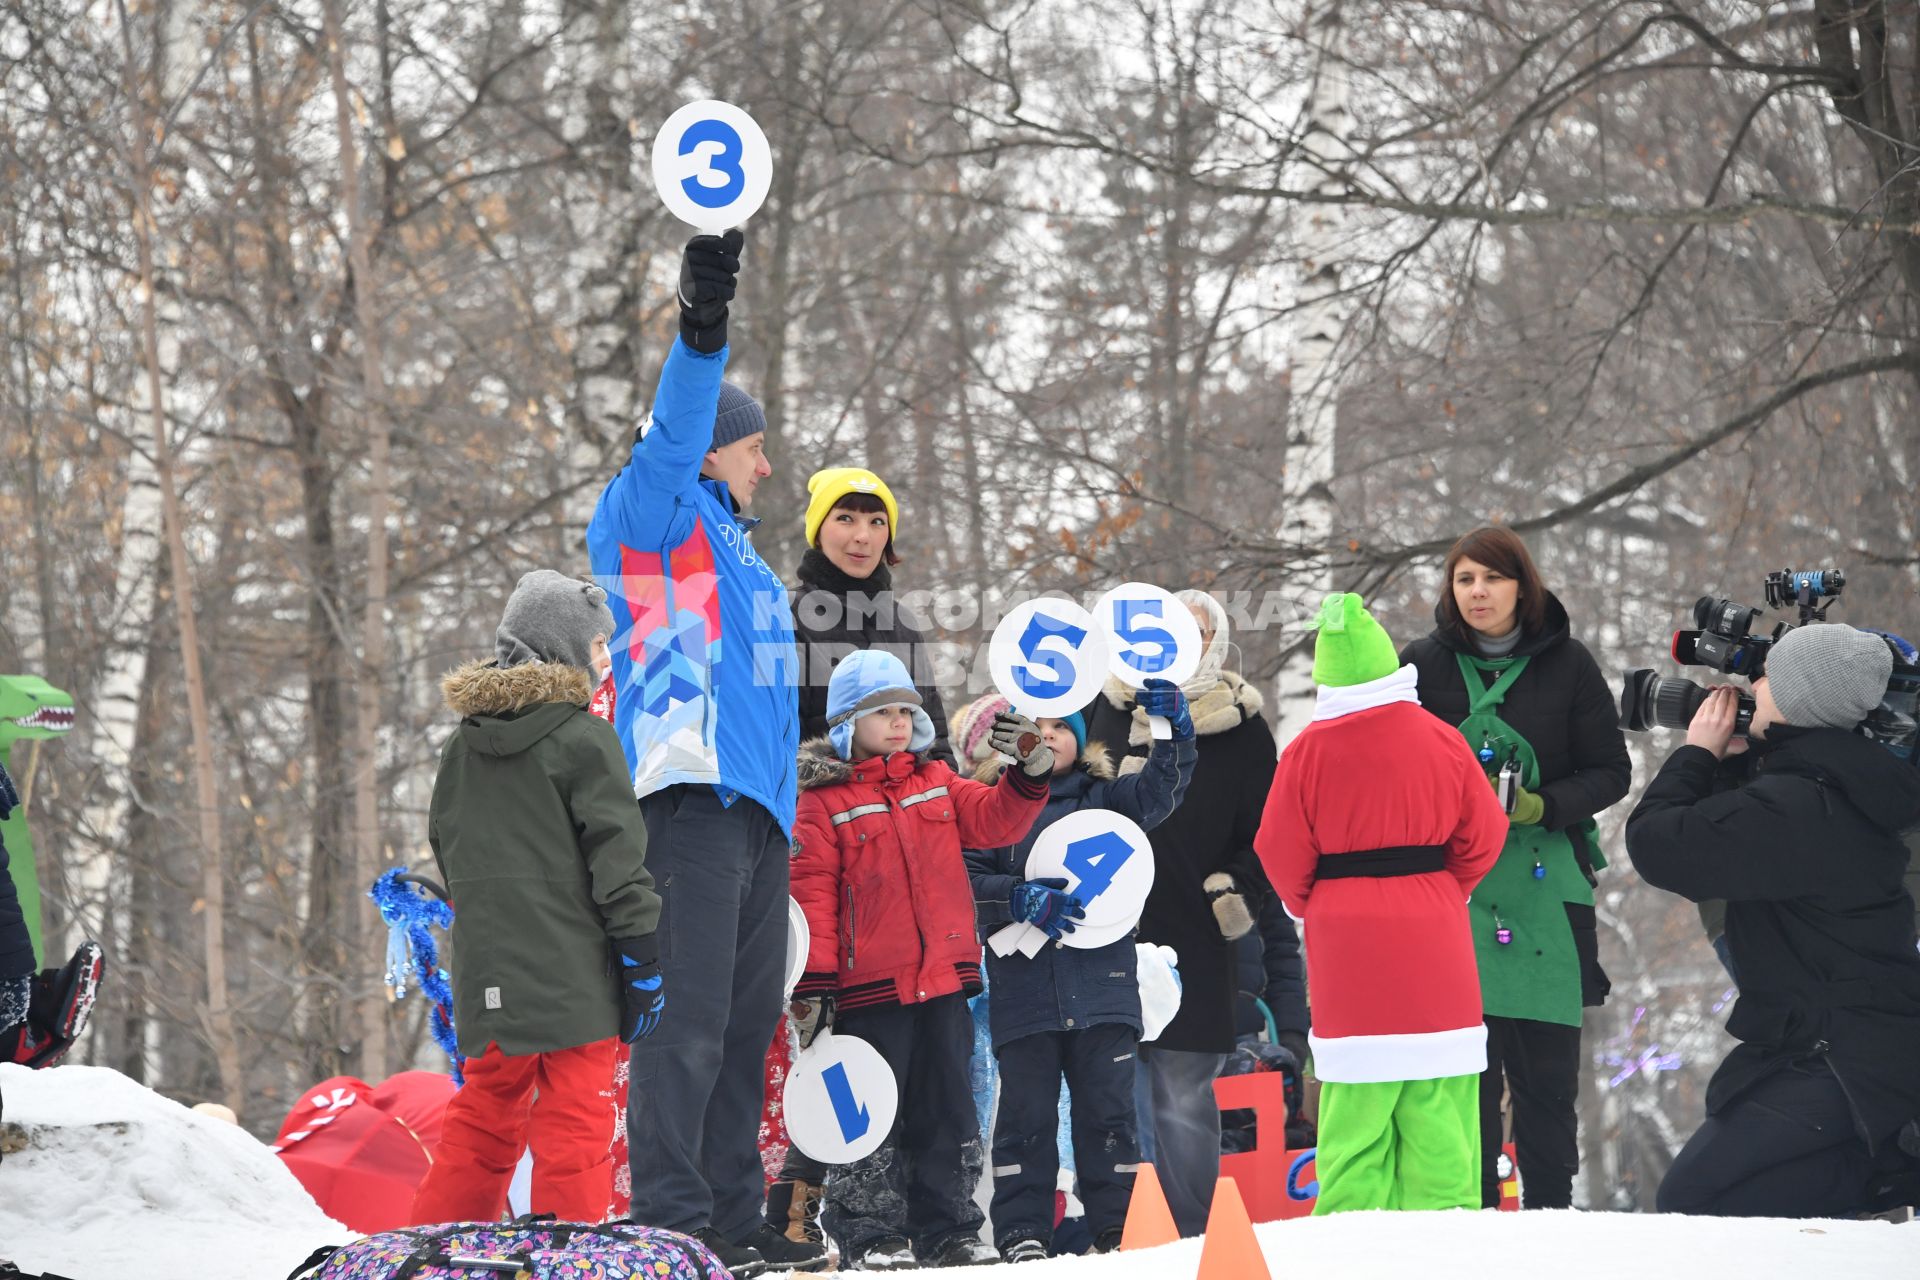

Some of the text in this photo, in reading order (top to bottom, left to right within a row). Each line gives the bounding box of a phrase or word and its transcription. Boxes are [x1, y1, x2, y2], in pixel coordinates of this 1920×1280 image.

[678, 119, 745, 208] 3
[1010, 613, 1087, 699] 5
[1113, 599, 1178, 673] 5
[1062, 831, 1135, 909] 4
[821, 1061, 870, 1145] 1
